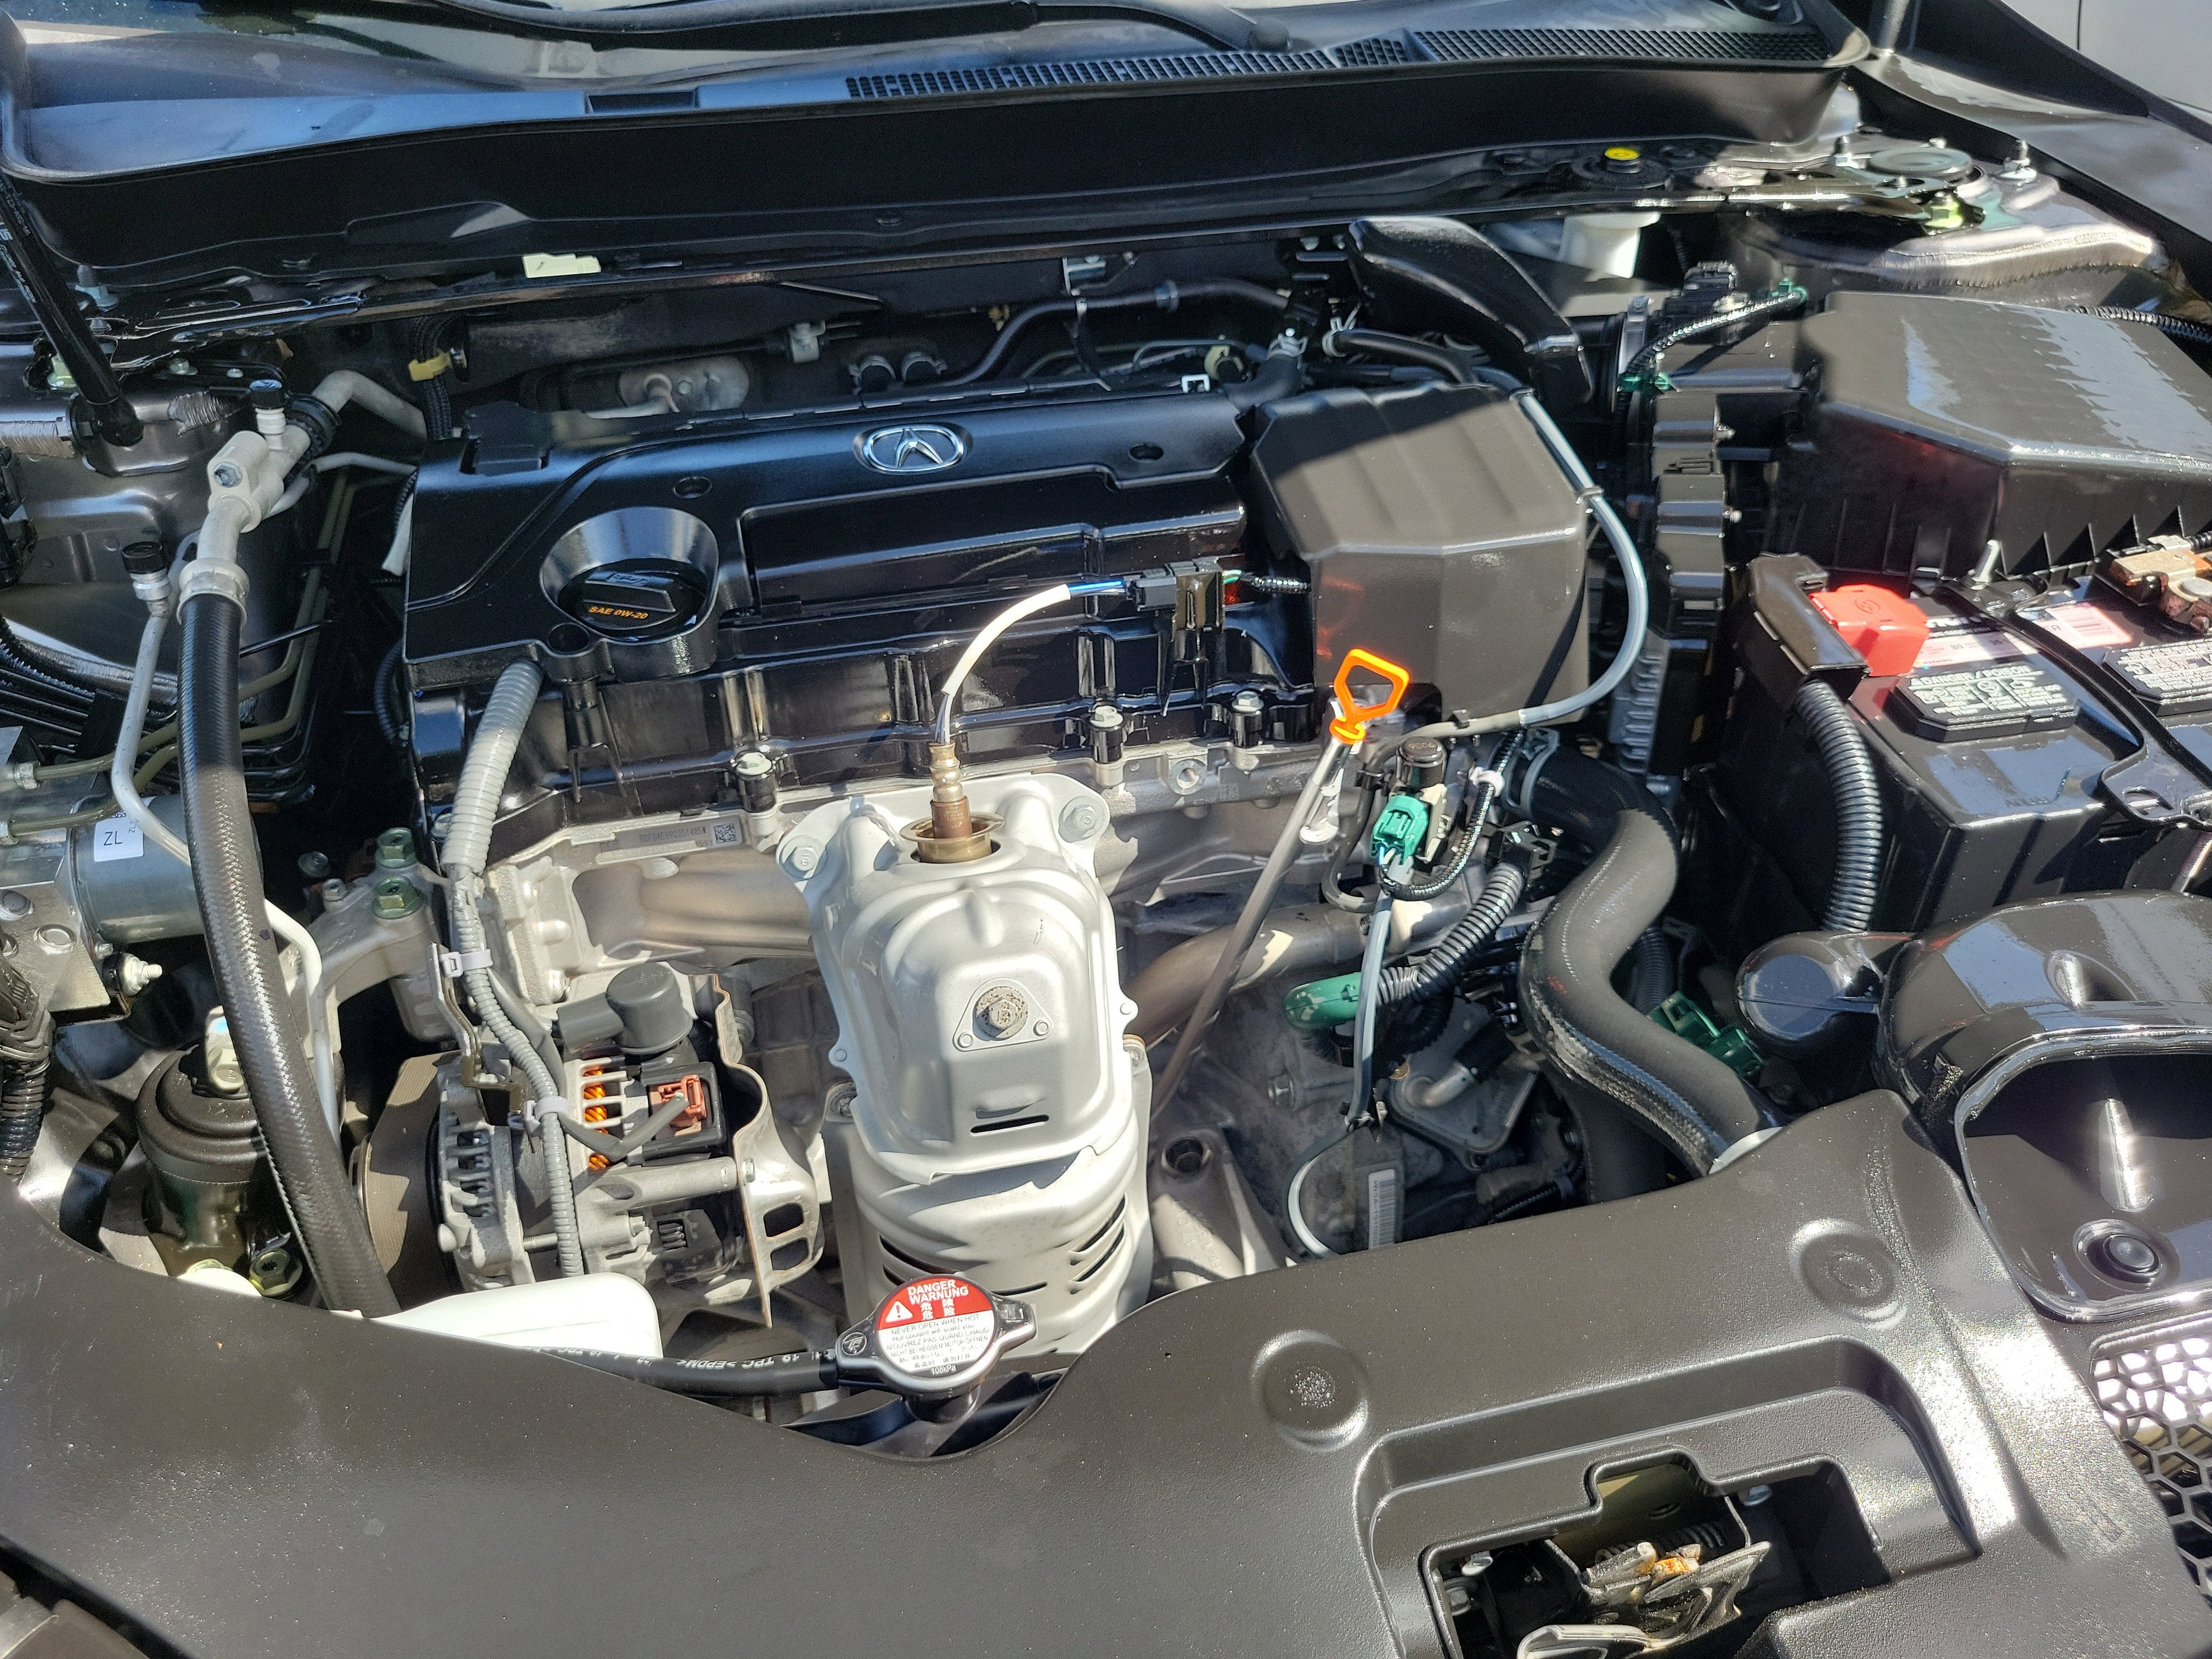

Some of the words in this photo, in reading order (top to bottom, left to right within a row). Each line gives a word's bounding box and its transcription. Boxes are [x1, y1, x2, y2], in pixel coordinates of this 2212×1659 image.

[588, 606, 613, 615] SAE
[614, 608, 648, 619] 0W-20
[1920, 672, 1974, 685] DANGER
[1982, 665, 2032, 677] POISON
[104, 831, 123, 846] ZL
[907, 1279, 957, 1296] DANGER
[910, 1286, 969, 1305] WARNUNG
[891, 1324, 916, 1335] NEVER
[918, 1320, 939, 1330] OPEN
[941, 1317, 963, 1325] WHEN
[964, 1314, 979, 1322] HOT
[887, 1339, 921, 1350] N'OUVREZ
[923, 1335, 936, 1343] PAS
[939, 1331, 963, 1341] QUAND
[965, 1327, 989, 1336] CHAUD
[906, 1330, 929, 1339] coolant
[891, 1349, 907, 1357] NICHT
[919, 1343, 943, 1352] HEISSEN
[945, 1339, 964, 1348] MOTOR
[931, 1364, 956, 1375] 108kPa
